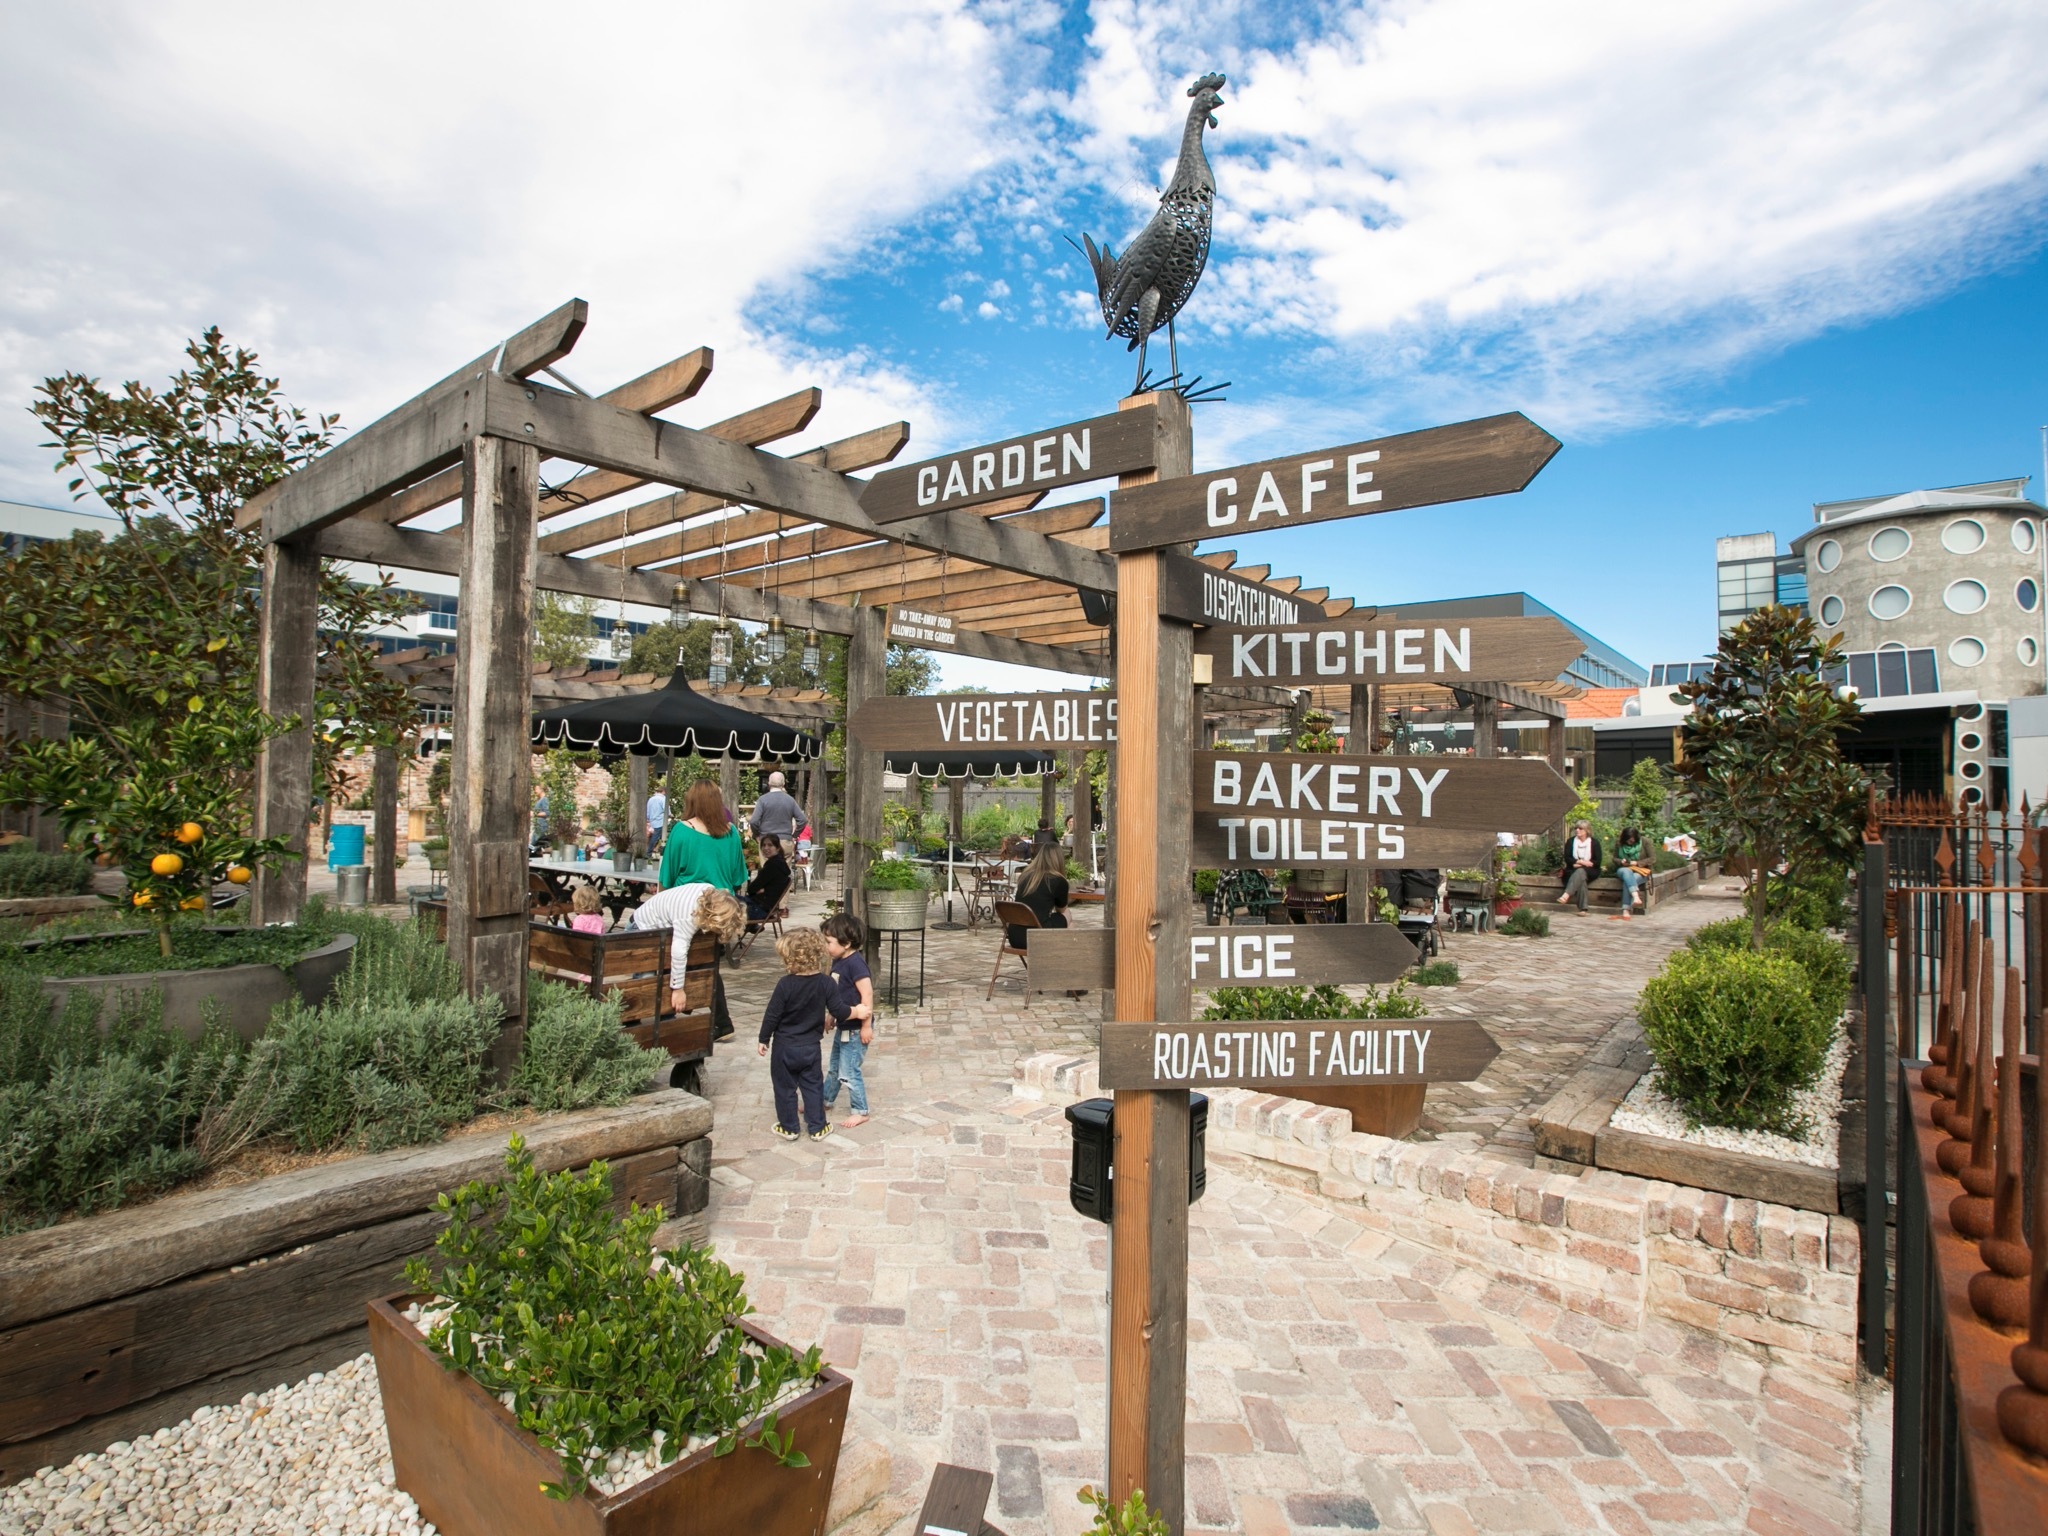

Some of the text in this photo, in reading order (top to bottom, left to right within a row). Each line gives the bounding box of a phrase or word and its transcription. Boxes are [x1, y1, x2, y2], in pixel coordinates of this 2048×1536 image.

[917, 428, 1091, 507] GARDEN
[1207, 450, 1382, 528] CAFE
[899, 610, 952, 629] NO TAKE-AWAY FOOD
[1204, 572, 1298, 626] DISPATCH ROOM
[891, 624, 916, 638] ALLOWED
[916, 628, 923, 639] IN
[924, 630, 934, 640] THE
[1231, 627, 1471, 678] KITCHEN
[936, 699, 1118, 742] VEGETABLES
[1213, 760, 1449, 818] BAKERY
[1218, 817, 1405, 861] TOILETS
[1154, 1029, 1431, 1080] ROASTING FACILITY
